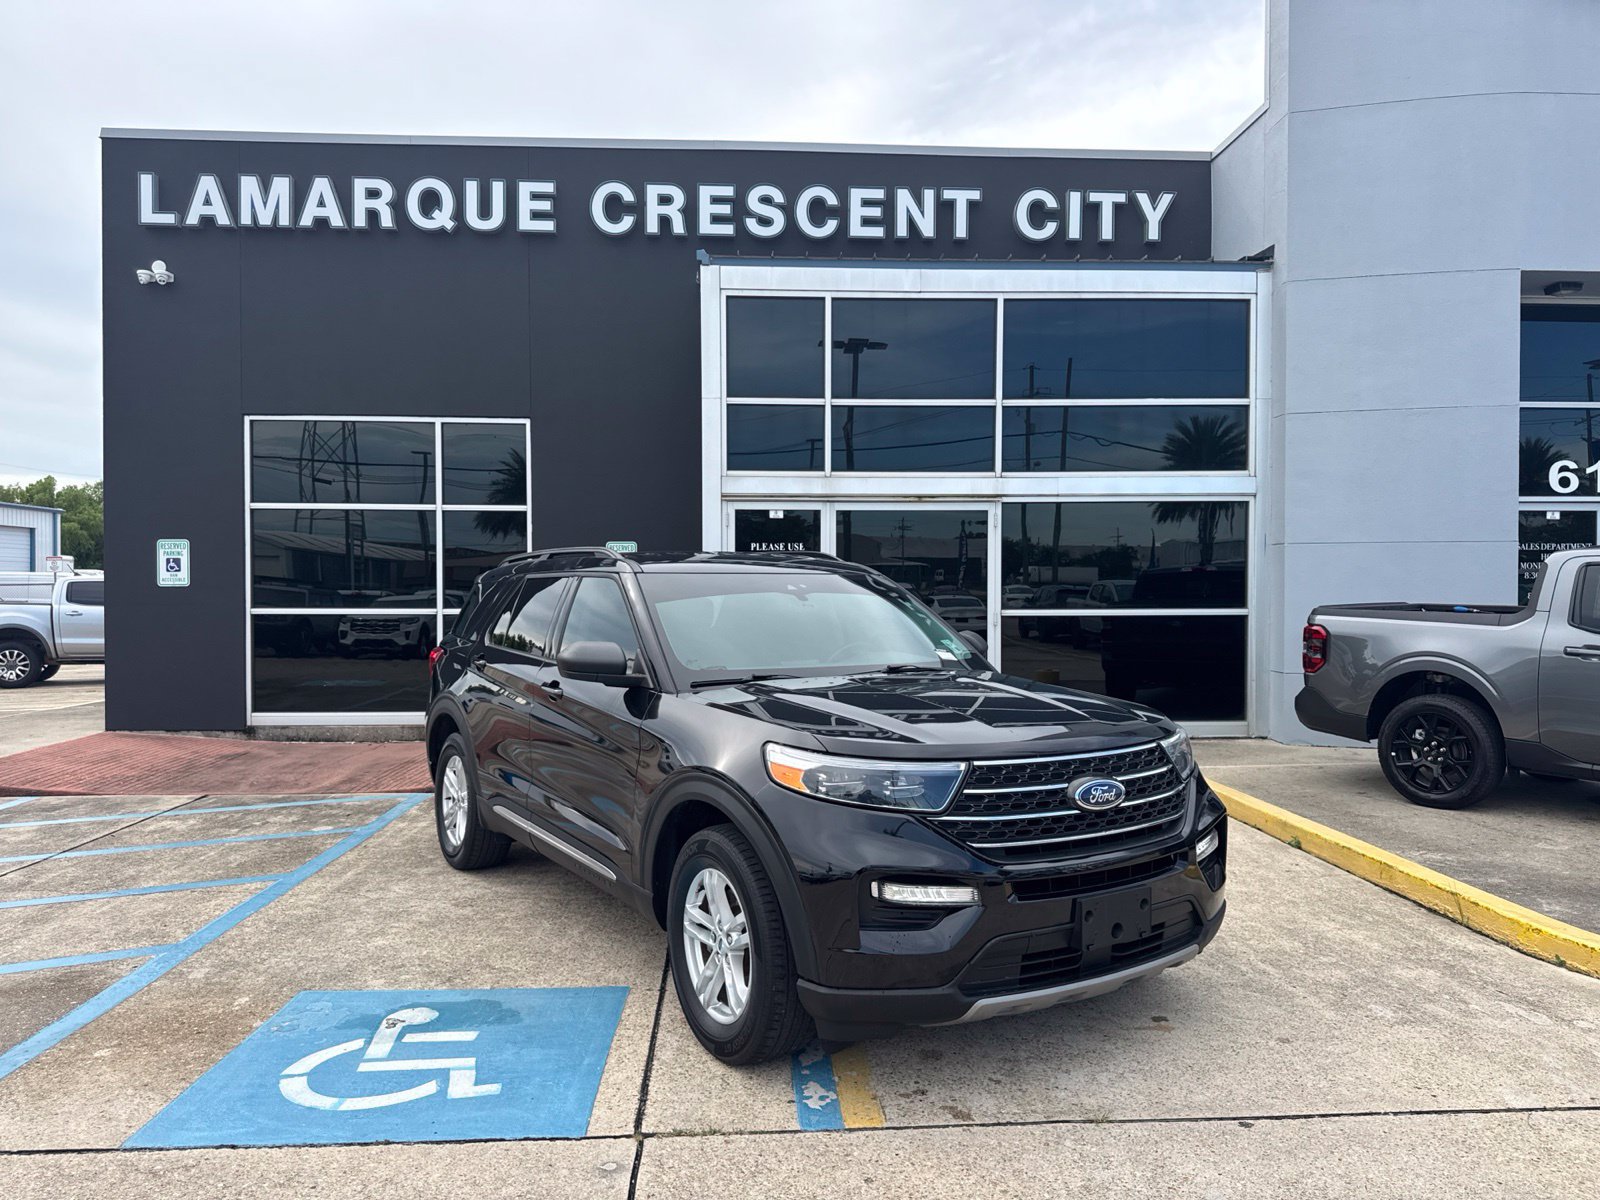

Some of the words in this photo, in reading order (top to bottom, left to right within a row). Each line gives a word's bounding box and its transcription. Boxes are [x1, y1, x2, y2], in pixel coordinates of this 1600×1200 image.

[137, 171, 557, 234] LAMARQUE
[590, 180, 983, 241] CRESCENT
[1013, 187, 1178, 243] CITY
[750, 542, 785, 551] PLEASE
[787, 542, 806, 551] USE
[1090, 786, 1116, 803] Ford
